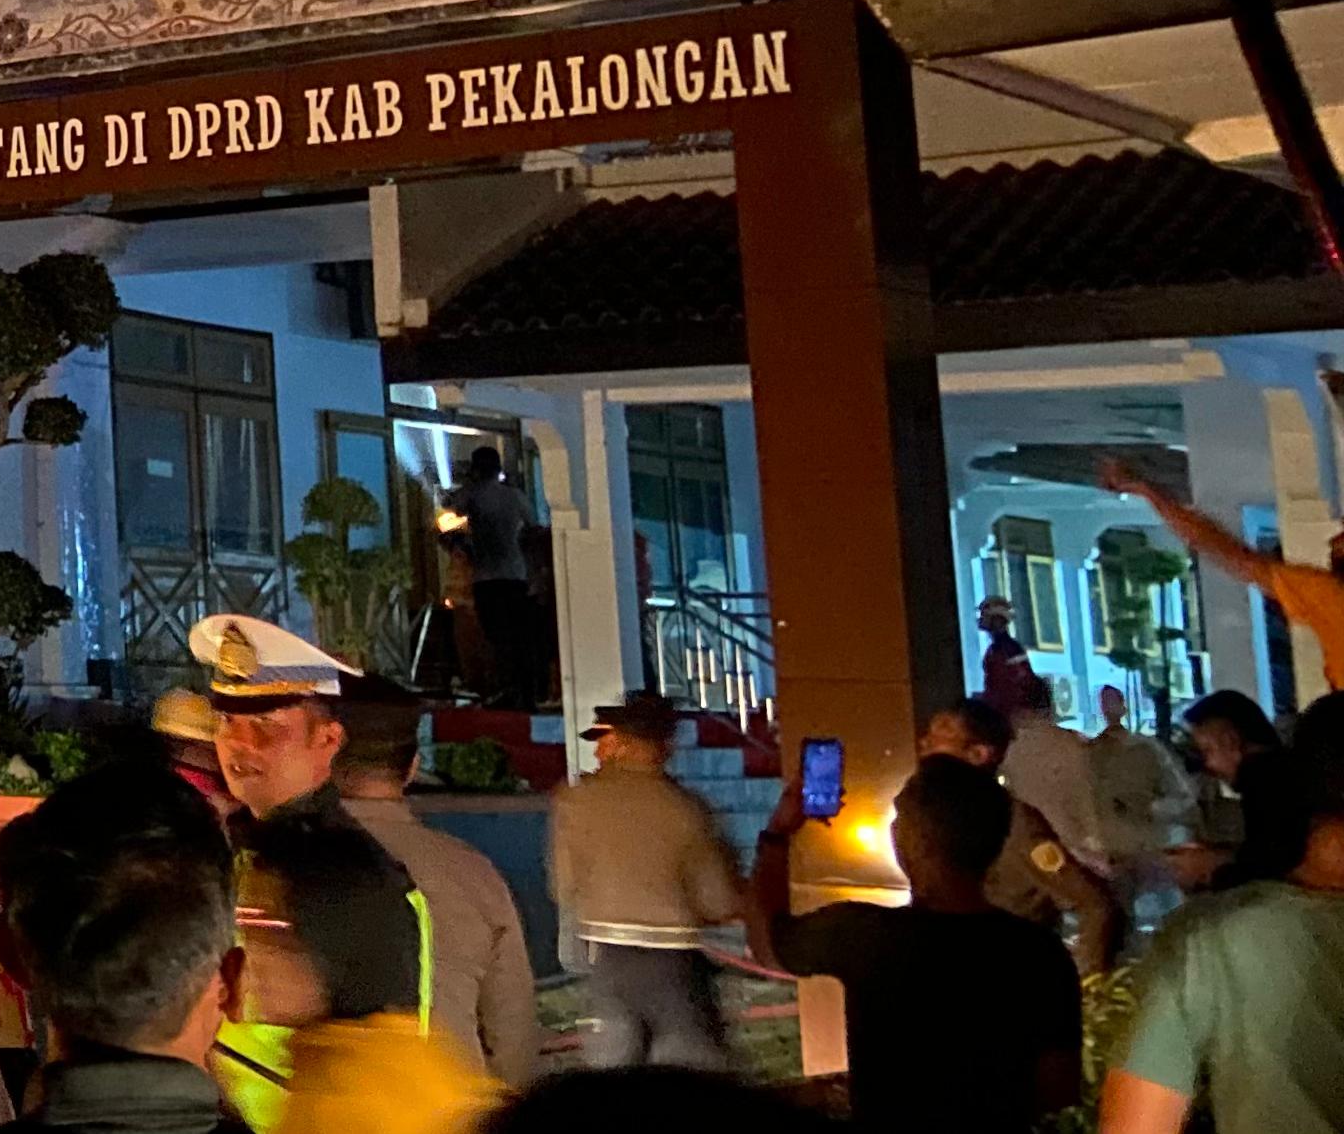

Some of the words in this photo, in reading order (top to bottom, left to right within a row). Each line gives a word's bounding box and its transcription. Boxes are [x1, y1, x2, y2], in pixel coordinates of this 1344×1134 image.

[104, 111, 148, 168] DI
[167, 95, 284, 161] DPRD
[304, 80, 404, 146] KAB
[425, 30, 792, 132] PEKALONGAN
